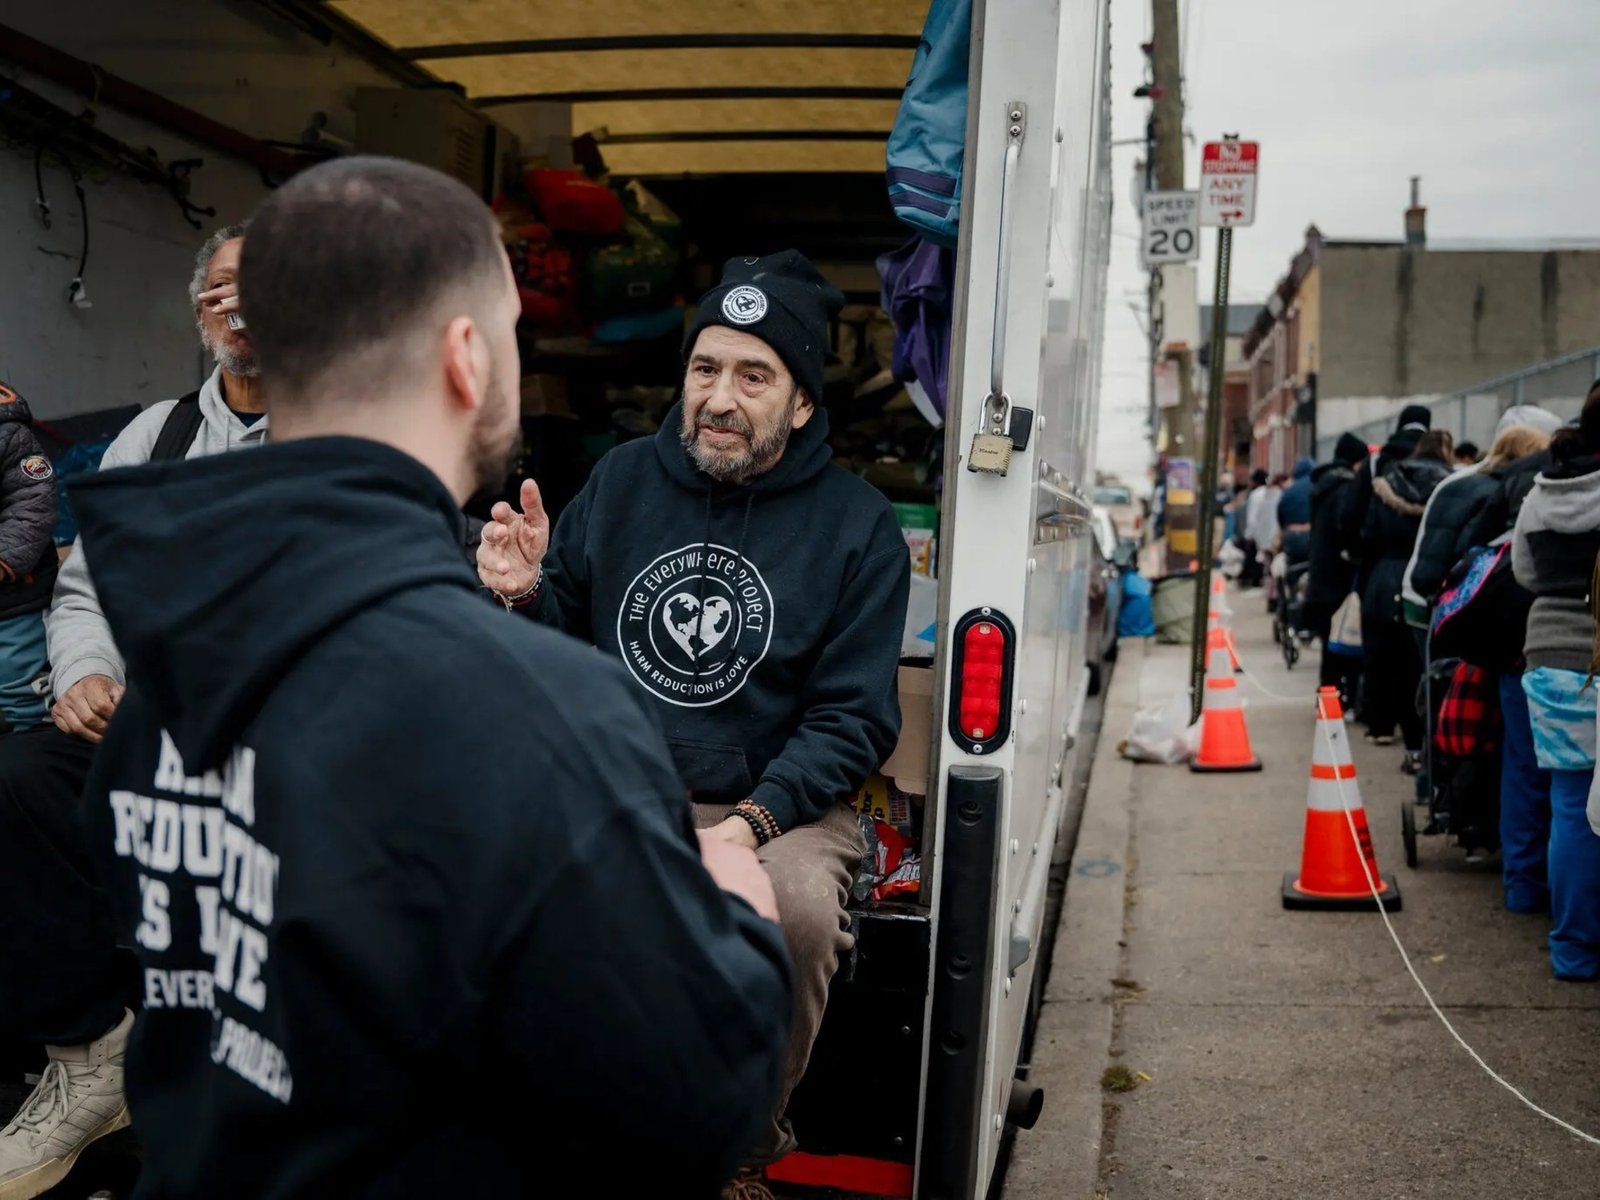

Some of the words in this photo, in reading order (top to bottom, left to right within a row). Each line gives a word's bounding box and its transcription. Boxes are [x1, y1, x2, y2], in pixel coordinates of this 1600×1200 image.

[1209, 178, 1245, 190] ANY
[1149, 198, 1195, 210] SPEED
[1209, 194, 1245, 206] TIME
[1151, 213, 1190, 226] LIMIT
[1149, 228, 1194, 256] 20
[629, 640, 653, 673] HARM
[650, 669, 714, 694] REDUCION
[715, 679, 725, 691] IS
[725, 655, 748, 683] LOVE
